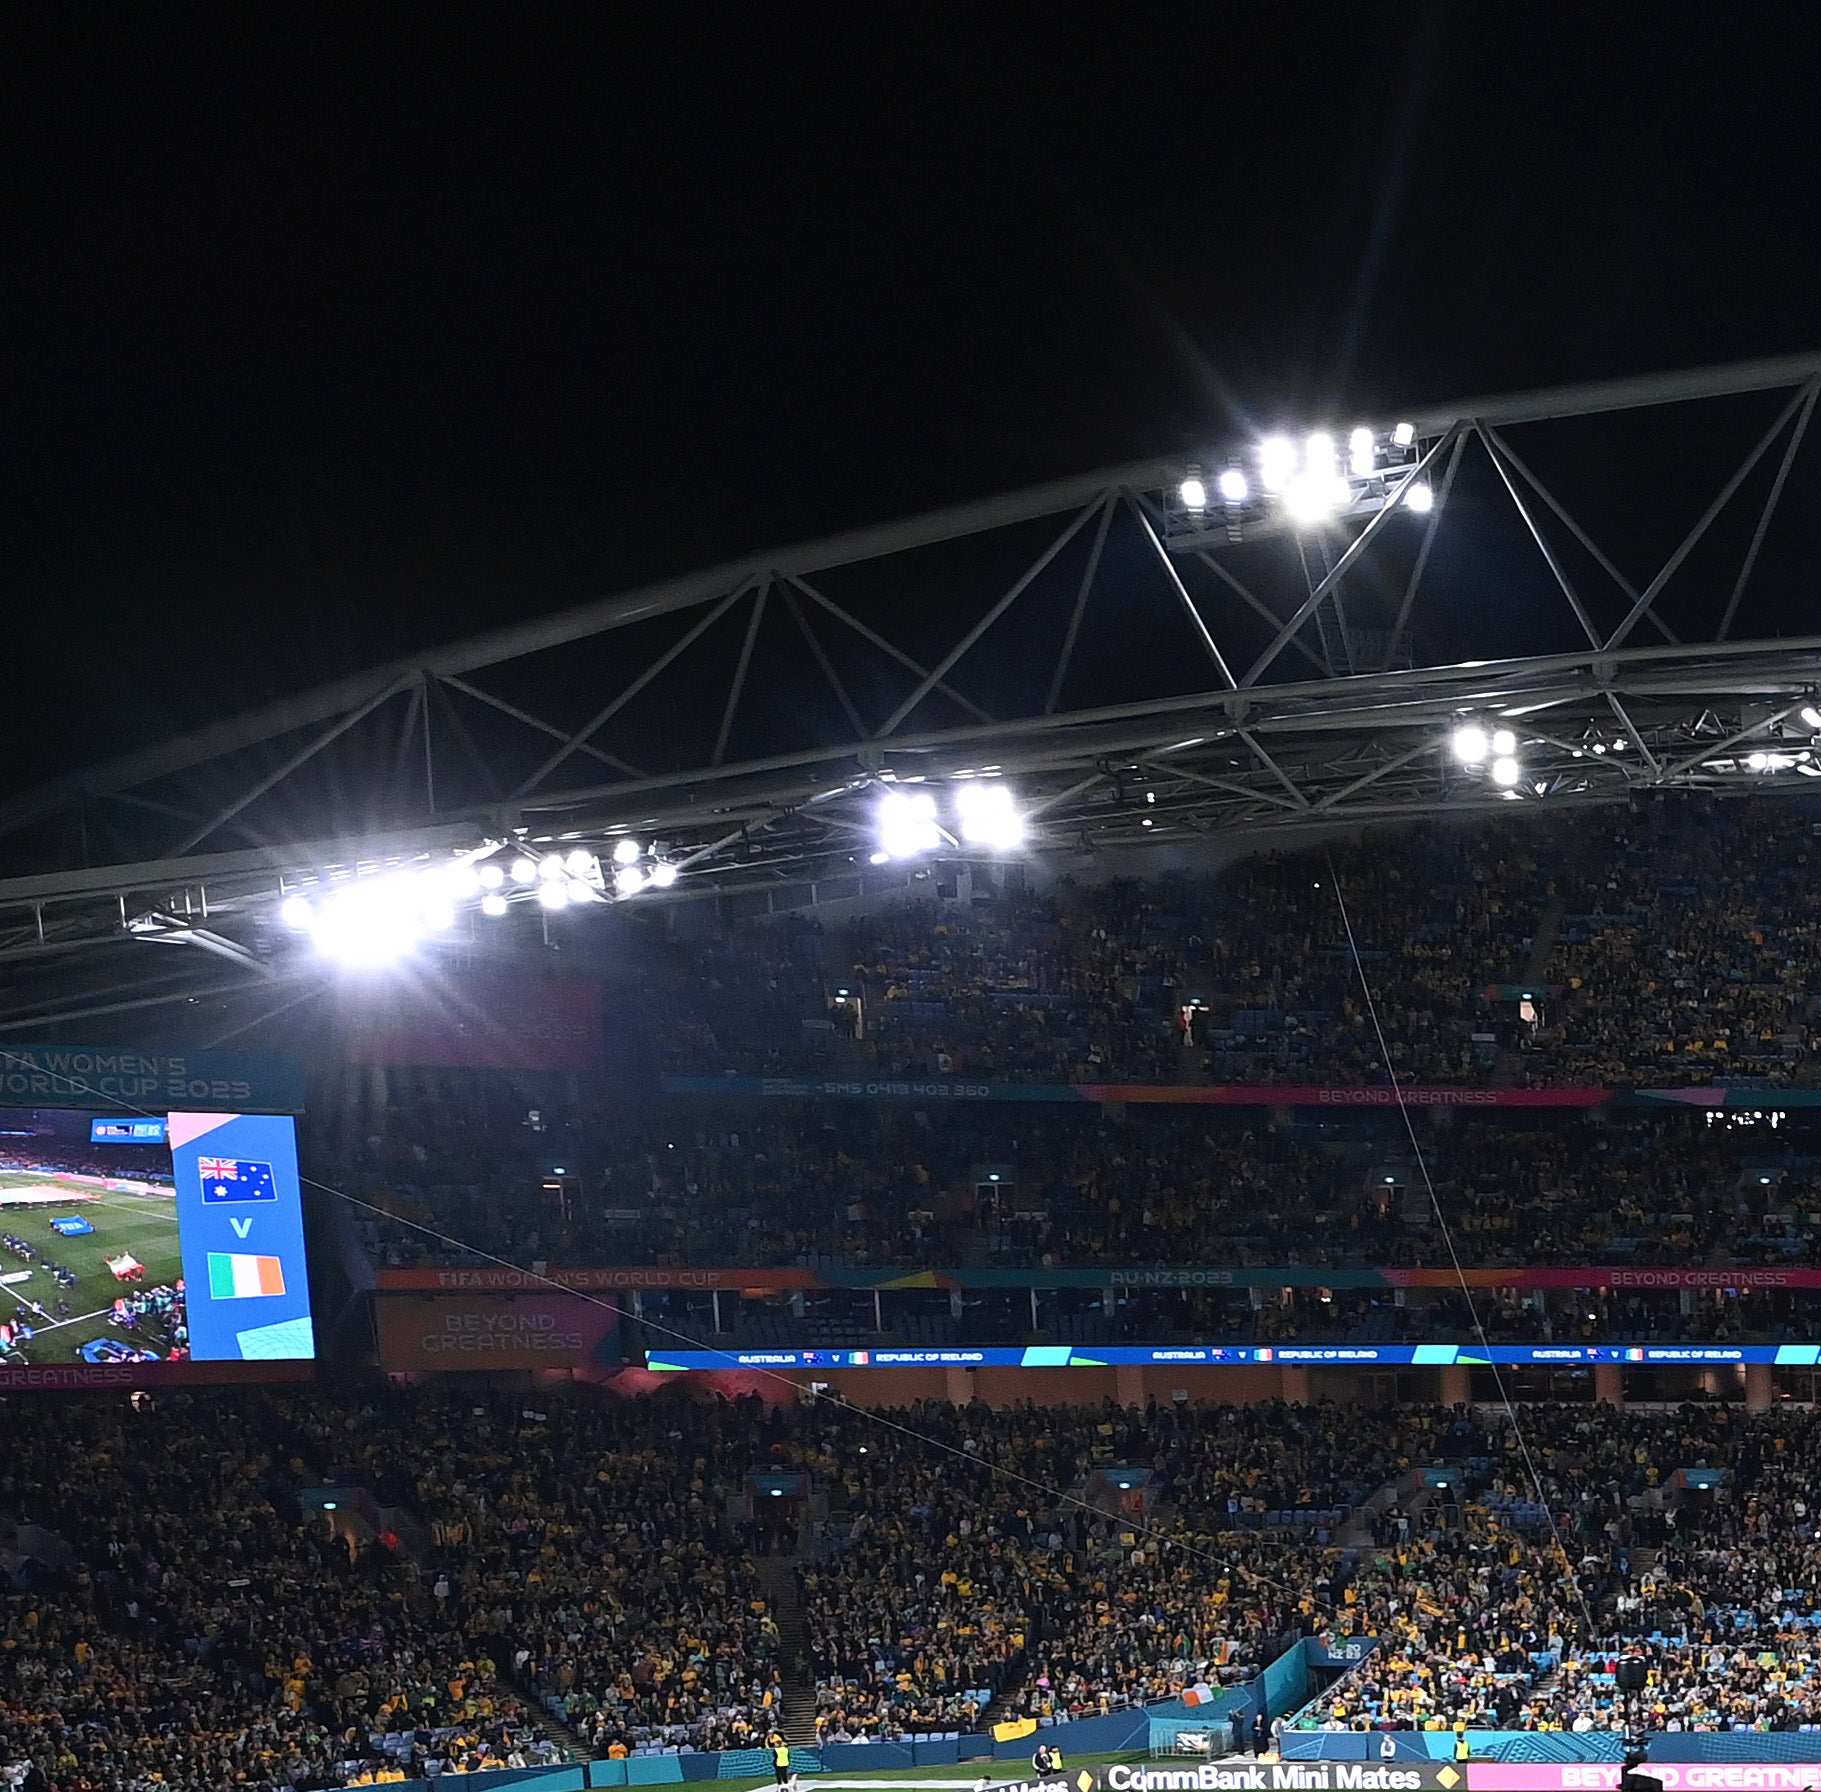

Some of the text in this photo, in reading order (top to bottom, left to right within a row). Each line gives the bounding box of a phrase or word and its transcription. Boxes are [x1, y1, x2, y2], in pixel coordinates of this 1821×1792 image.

[100, 1077, 160, 1098] CUP
[166, 1079, 251, 1100] 2023
[1319, 1090, 1391, 1104] BEYOND
[229, 1217, 253, 1239] V
[438, 1272, 722, 1287] FIFA WORLD CUP
[1610, 1272, 1681, 1285] BEYOND
[445, 1313, 557, 1332] BEYOND
[421, 1331, 585, 1353] GREATNESS
[875, 1353, 924, 1361] REPUBLIC
[941, 1353, 984, 1361] IRELAND
[1152, 1351, 1206, 1359] AUSTRALIA
[1278, 1350, 1323, 1359] REPUBLIC
[1338, 1350, 1378, 1359] IRELAND
[1532, 1350, 1582, 1358] AUSTRALIA
[1648, 1350, 1692, 1359] REPUBLIC
[1707, 1350, 1745, 1359] IRELAND
[1108, 1764, 1422, 1791] CommBank Mini Mates
